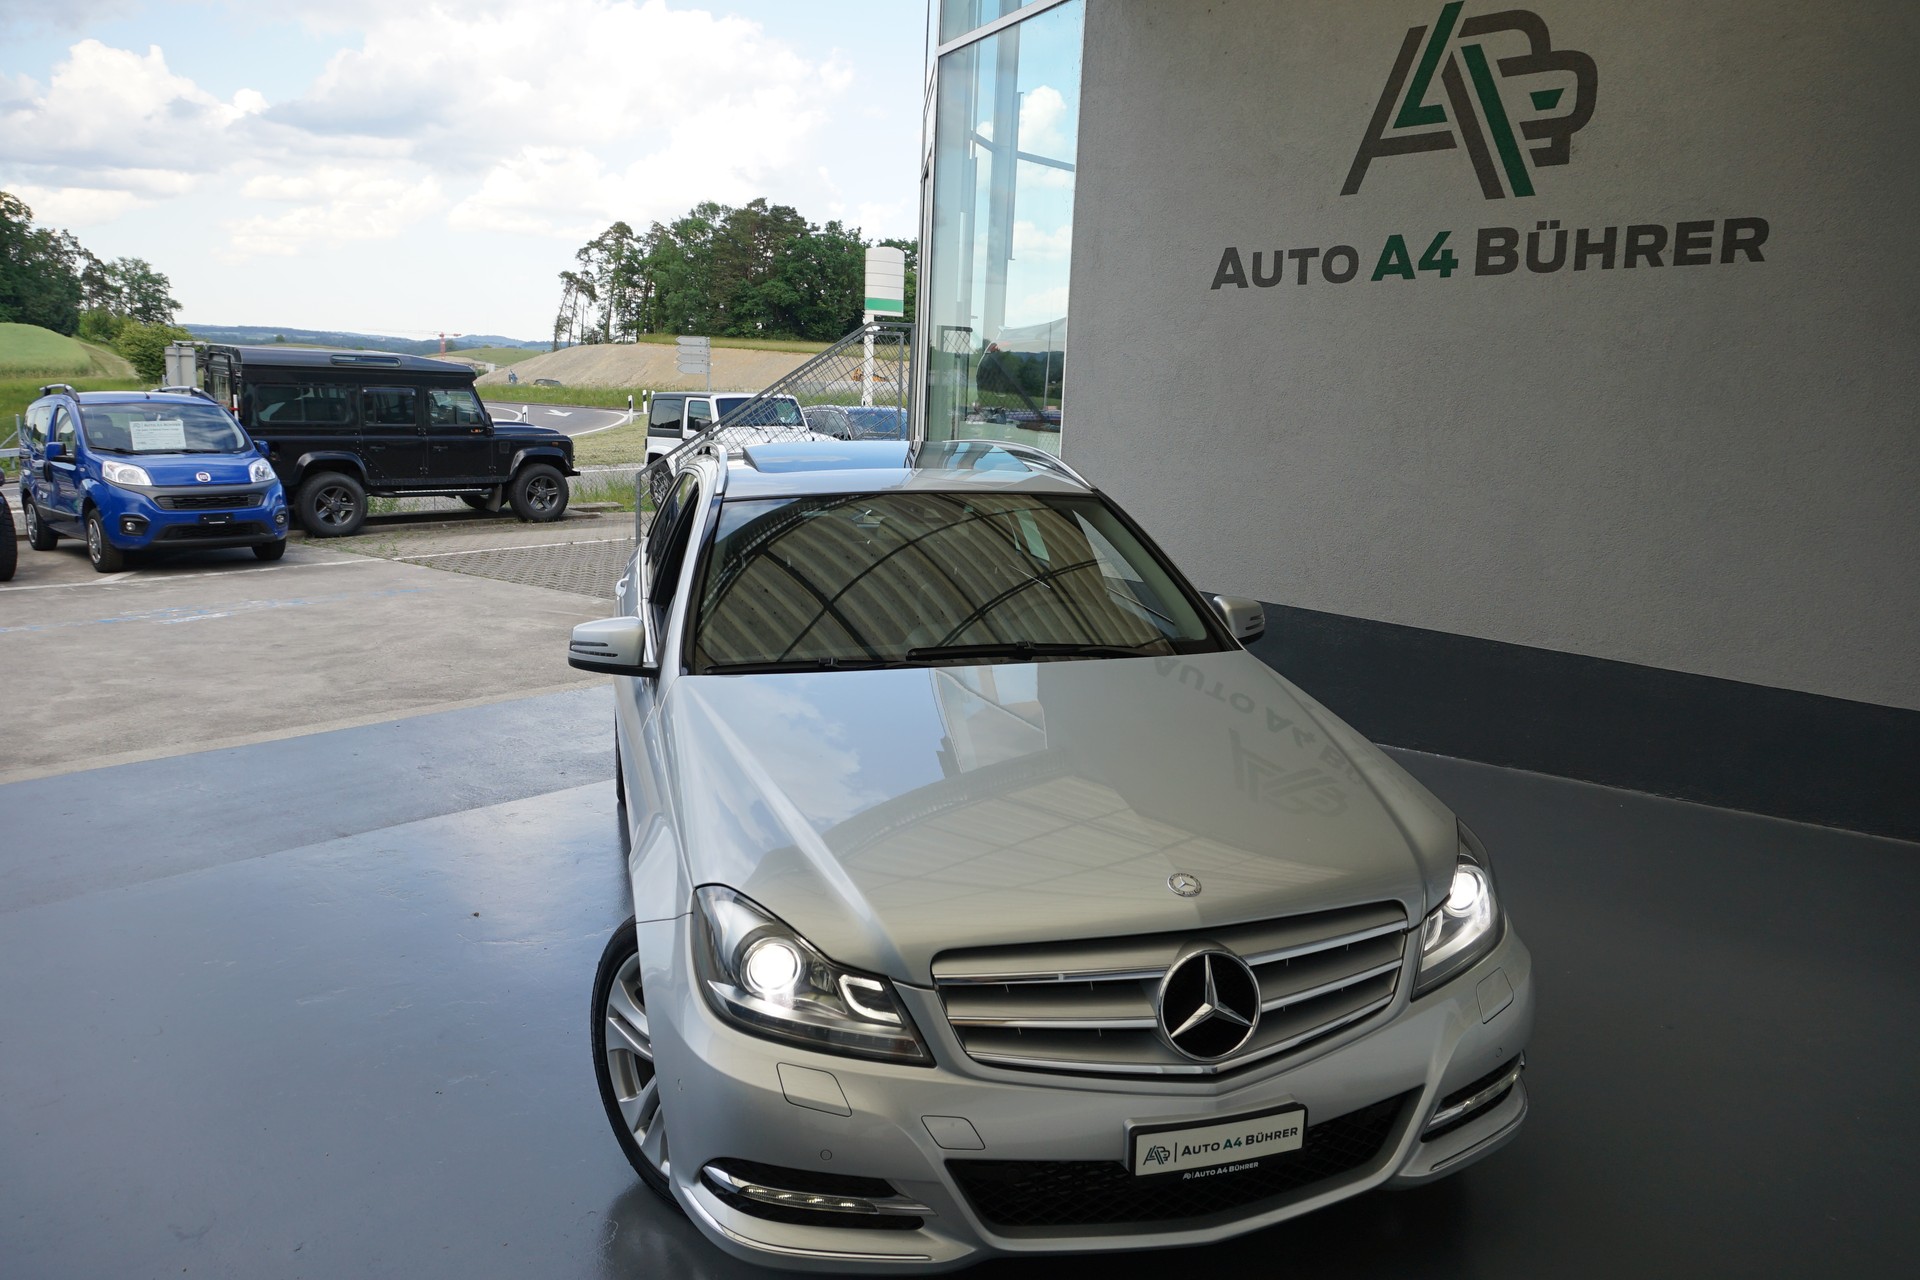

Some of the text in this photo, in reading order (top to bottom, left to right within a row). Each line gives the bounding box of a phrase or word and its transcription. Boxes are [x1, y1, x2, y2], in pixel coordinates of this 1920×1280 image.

[1210, 216, 1770, 290] AUTO A4 BÜHRER
[1181, 1142, 1220, 1157] AUTO
[1223, 1137, 1242, 1150] A4
[1245, 1127, 1298, 1146] BÜHRER
[1194, 1169, 1216, 1178] AUTO
[1216, 1166, 1228, 1175] A4
